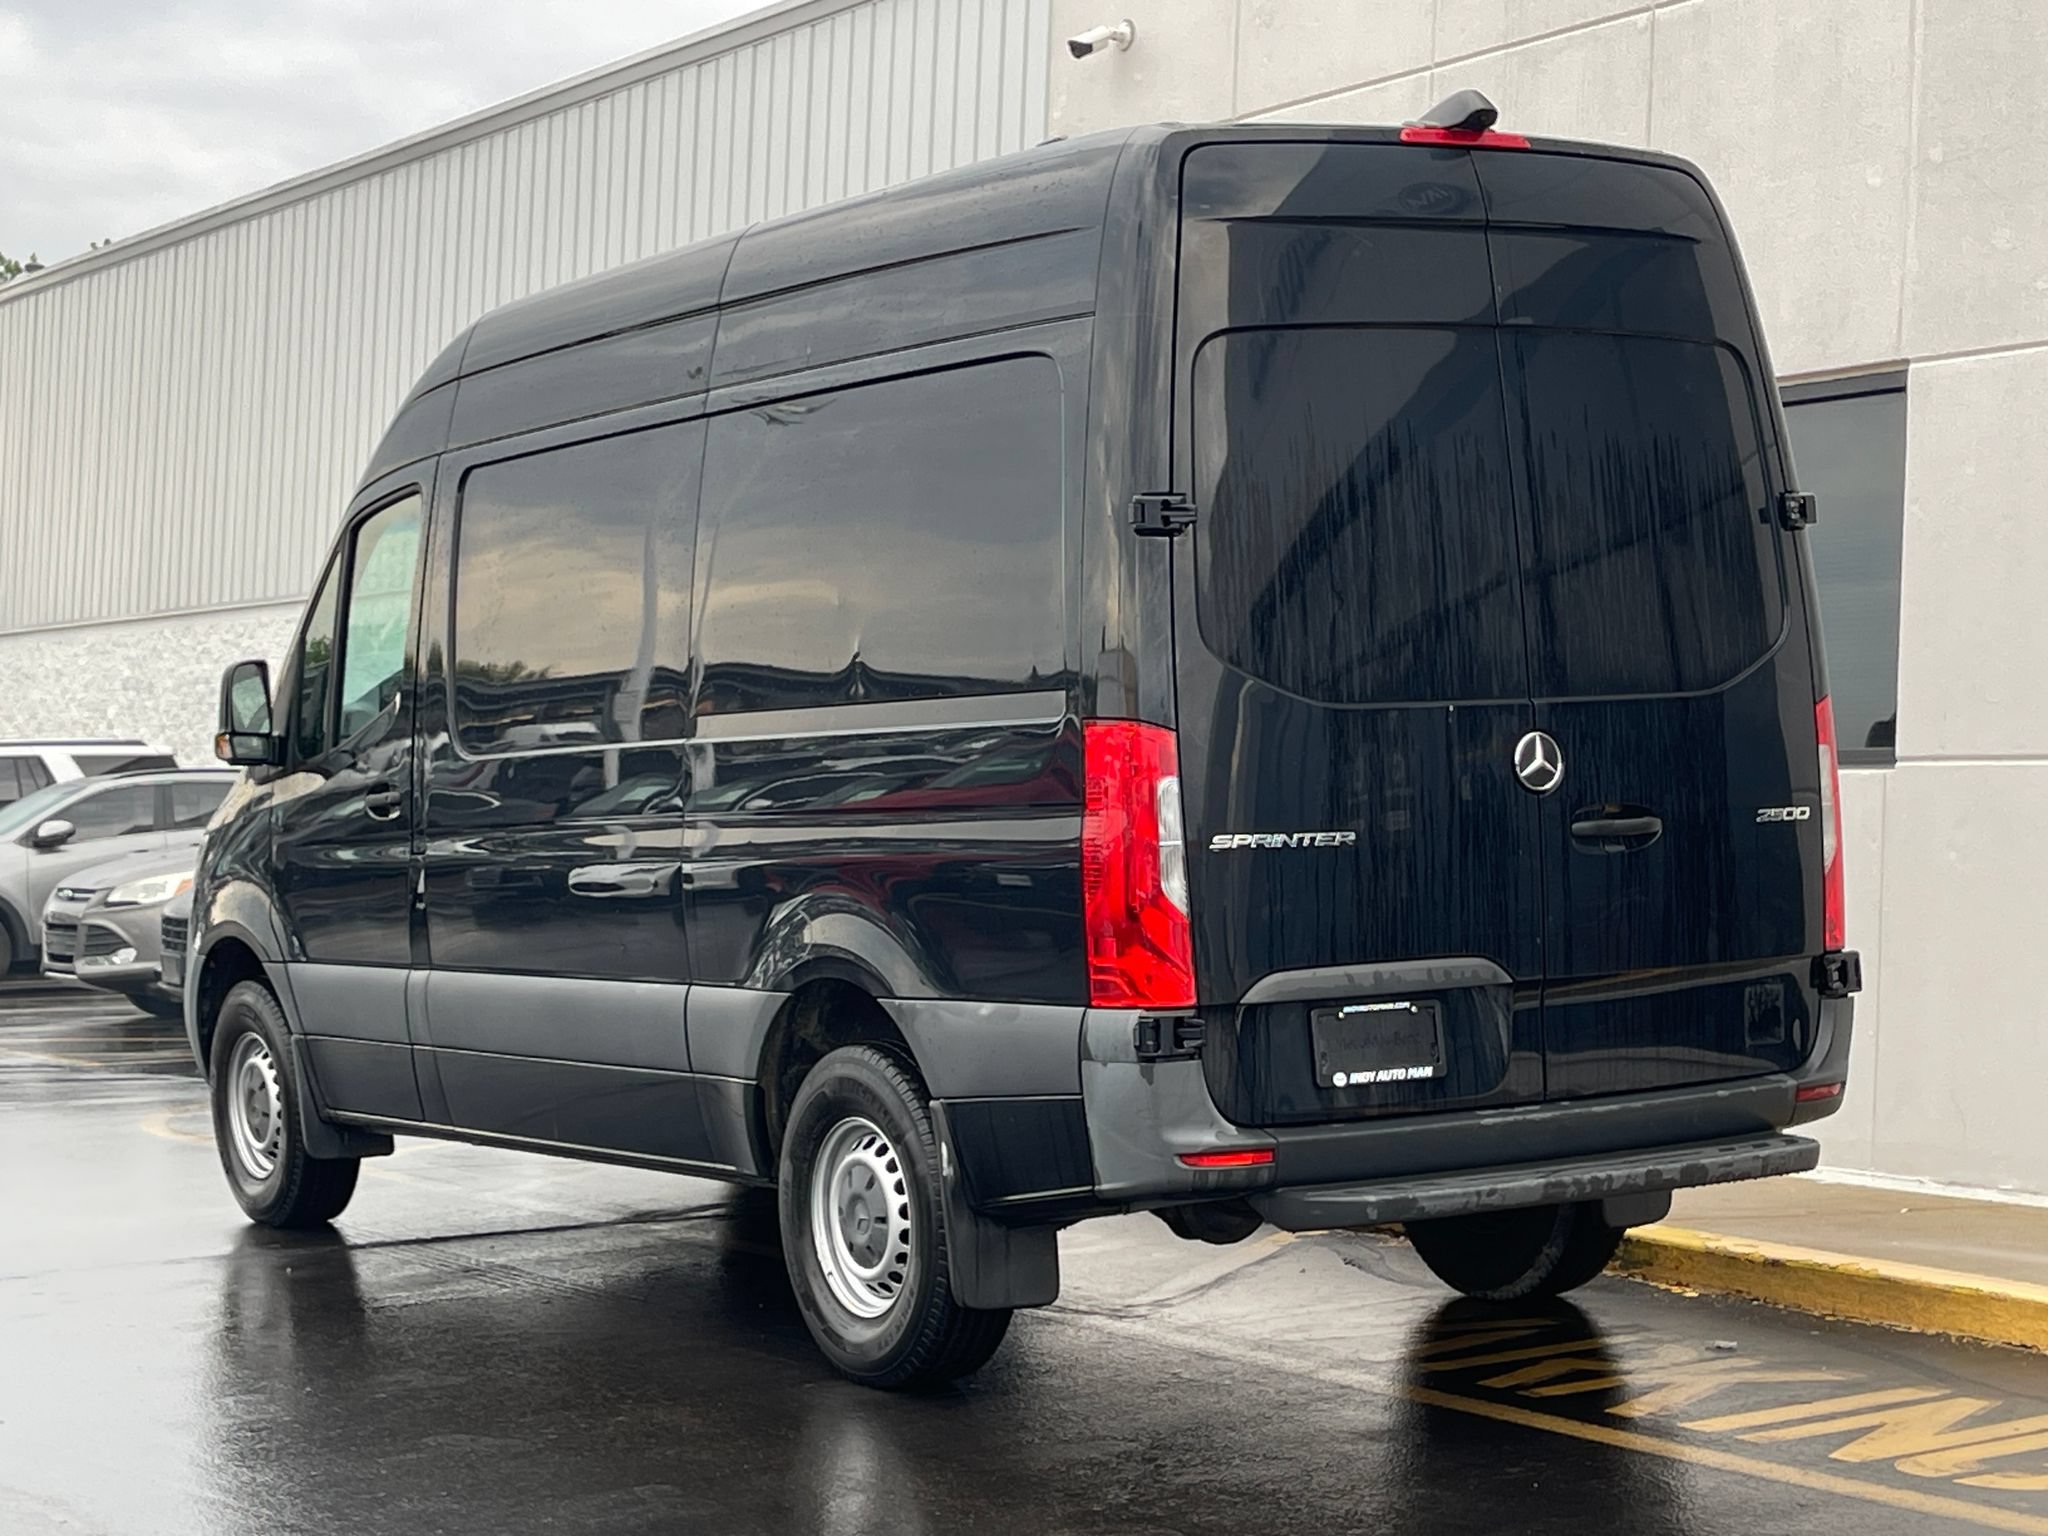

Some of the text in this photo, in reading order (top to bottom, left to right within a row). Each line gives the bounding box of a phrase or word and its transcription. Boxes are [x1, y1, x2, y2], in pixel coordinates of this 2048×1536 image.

[1756, 806, 1811, 822] 2500
[1209, 831, 1357, 851] SPRINTER
[1376, 1068, 1406, 1082] AUTO
